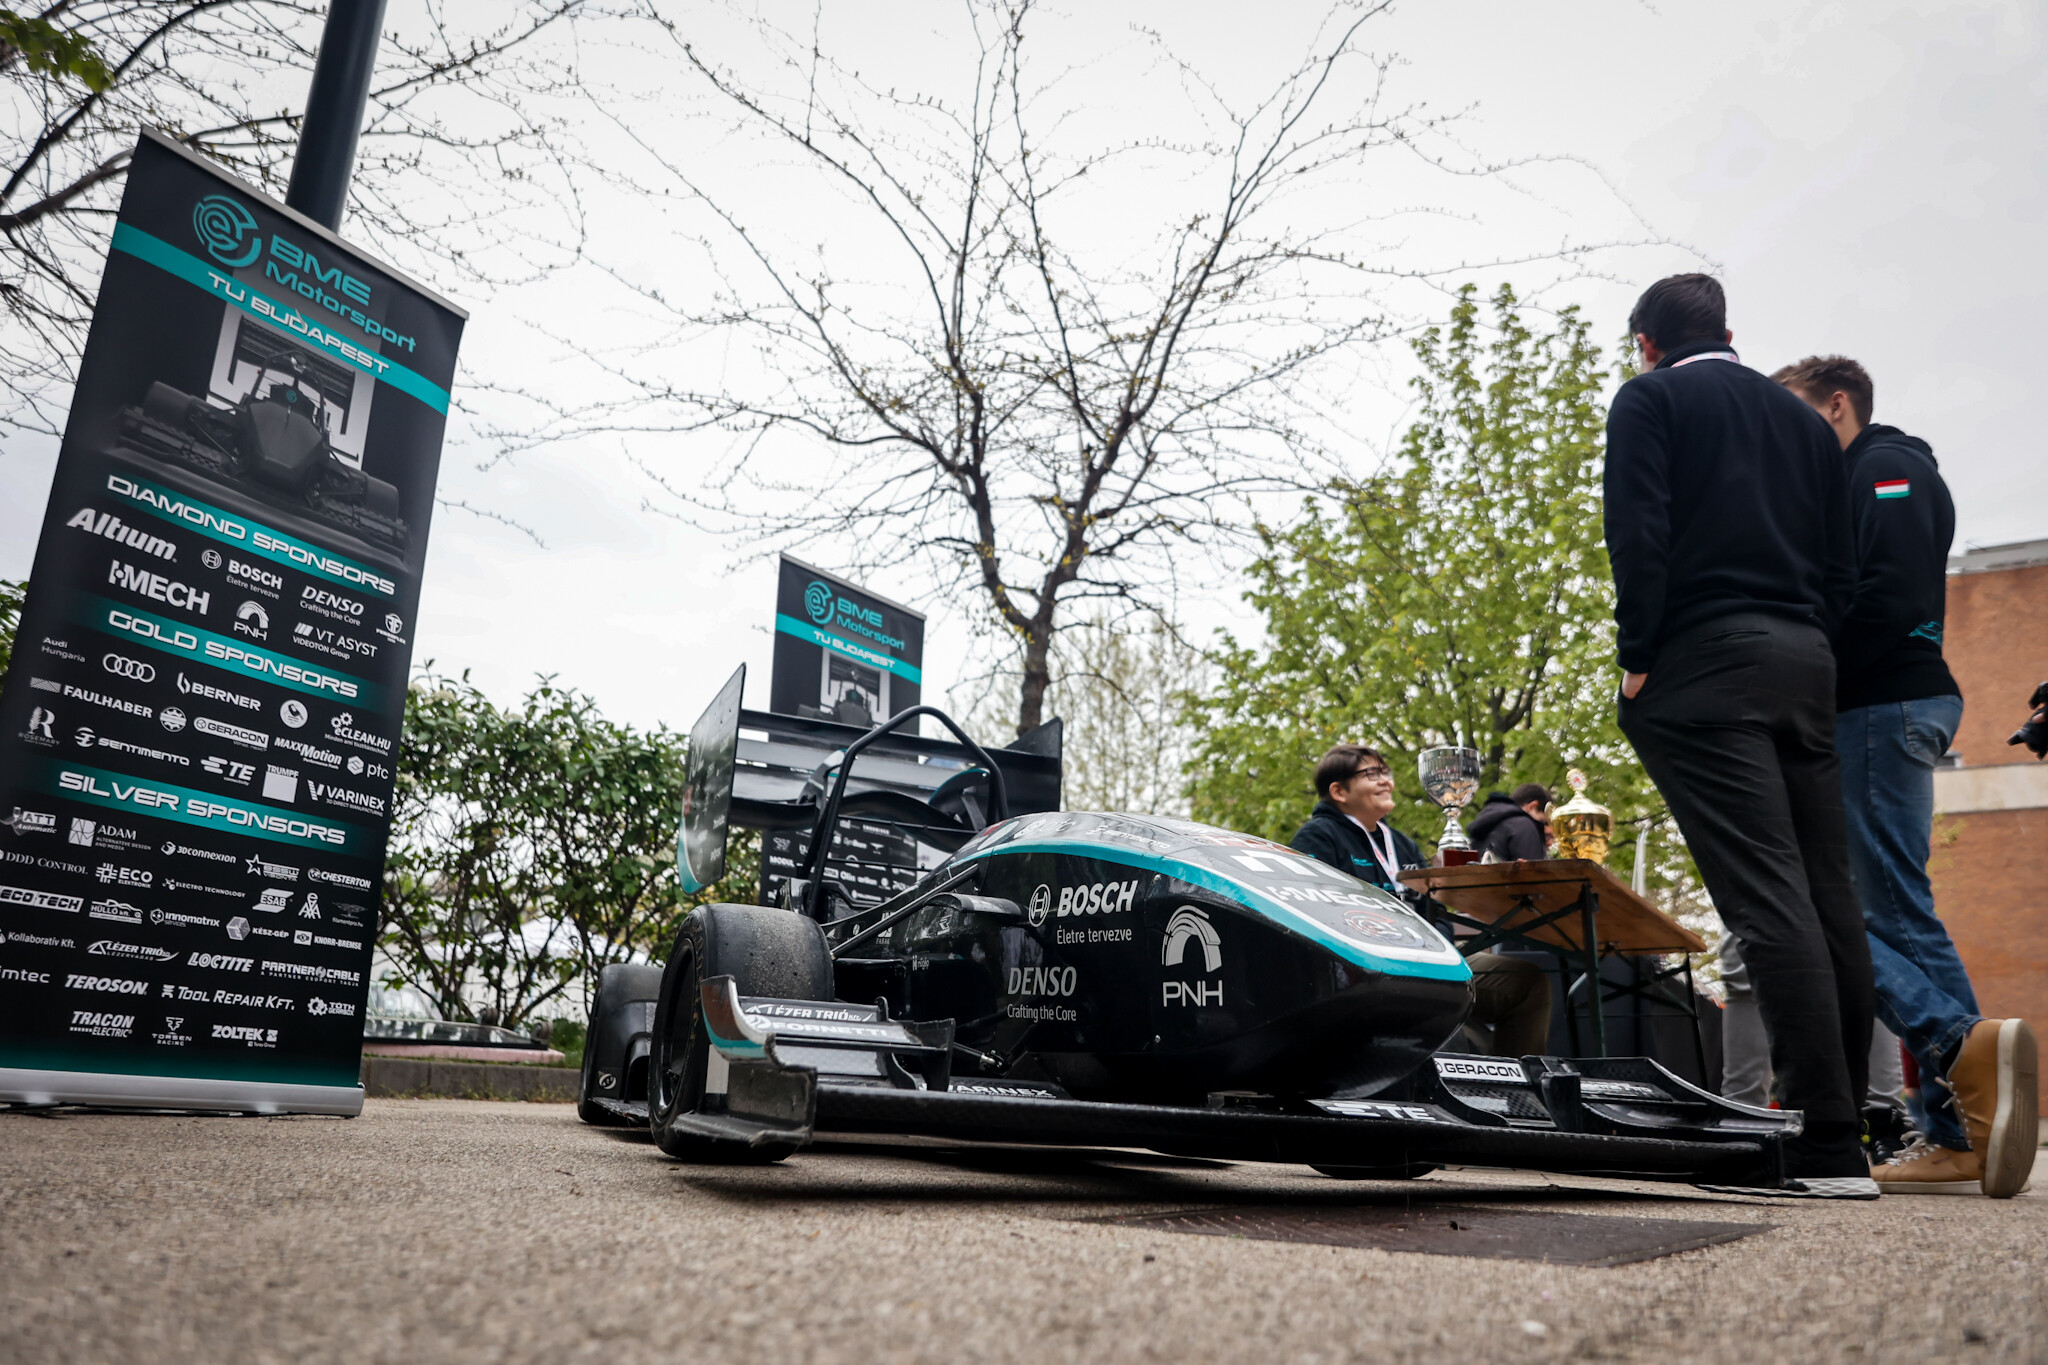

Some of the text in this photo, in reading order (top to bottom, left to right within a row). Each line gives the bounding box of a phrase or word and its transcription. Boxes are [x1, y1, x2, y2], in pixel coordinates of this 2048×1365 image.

[270, 234, 372, 307] BME
[265, 260, 416, 353] Motorsport
[207, 271, 389, 375] TU BUDAPEST
[66, 508, 177, 561] Altium
[107, 474, 396, 596] DIAMOND SPONSORS
[228, 558, 283, 591] BOSCH
[226, 573, 280, 600] Életre tervezve
[301, 585, 365, 617] DENSO
[300, 600, 361, 627] Crafting the Core
[837, 596, 884, 629] BME
[233, 621, 268, 641] PNH
[836, 614, 906, 651] Motorsport
[43, 636, 68, 649] Audi
[292, 635, 351, 661] VIDEOTON Group
[315, 627, 378, 658] VT ASYST
[813, 630, 896, 669] TU BUDAPEST
[41, 645, 86, 663] Hungaria
[108, 610, 359, 698] GOLD SPONSORS
[63, 684, 153, 719] FAULHABER
[191, 682, 262, 712] BERNER
[18, 732, 61, 746] ROSEMARY
[207, 722, 266, 744] GERACON
[334, 727, 392, 751] eCLEAN.HU
[98, 737, 190, 767] SENTIMENTO
[274, 736, 343, 766] MAXXMotion
[228, 760, 257, 781] TE
[266, 764, 299, 778] TRUMPF
[366, 763, 389, 780] ptc
[58, 771, 346, 845] SILVER SPONSORS
[326, 784, 385, 812] VARINEX
[16, 823, 58, 834] Automatic
[24, 812, 55, 825] ATT
[97, 824, 137, 841] ADAM
[1103, 829, 1171, 849] SENTIMENTO
[96, 836, 152, 851] ALTERNATIVE DESIGN
[6, 851, 35, 865] DDD
[118, 866, 153, 883] ECO
[118, 878, 152, 889] ELEKTRONIK
[320, 871, 372, 889] CHESTERTON
[176, 882, 246, 899] ELECTRO TECHNOLOGY
[260, 894, 287, 907] ESAB
[1056, 879, 1139, 918] BOSCH
[164, 919, 187, 928] services
[252, 926, 290, 939] KÉSZ-GÉP
[60, 938, 77, 949] Kft.
[314, 935, 363, 950] KNORR-BREMSE
[1056, 925, 1132, 945] Életre tervezve
[106, 942, 140, 954] LÉZER
[140, 946, 164, 956] TRIÓ
[187, 951, 255, 973] LOCTITE
[261, 960, 360, 982] PARTNER CABLE
[64, 974, 149, 996] TEROSON
[1007, 966, 1078, 997] DENSO
[1162, 979, 1224, 1008] PNH
[71, 1011, 136, 1029] TRACON
[815, 1009, 849, 1021] TRIÓ
[1007, 1003, 1077, 1024] Crafting the Core
[91, 1026, 129, 1038] ELECTRIC
[151, 1033, 193, 1042] TORSEN
[211, 1024, 265, 1041] ZOLTEK
[770, 1021, 888, 1037] FORNETTI
[156, 1039, 185, 1047] RACING
[1444, 1062, 1522, 1078] GERACON
[1377, 1105, 1437, 1122] TE
